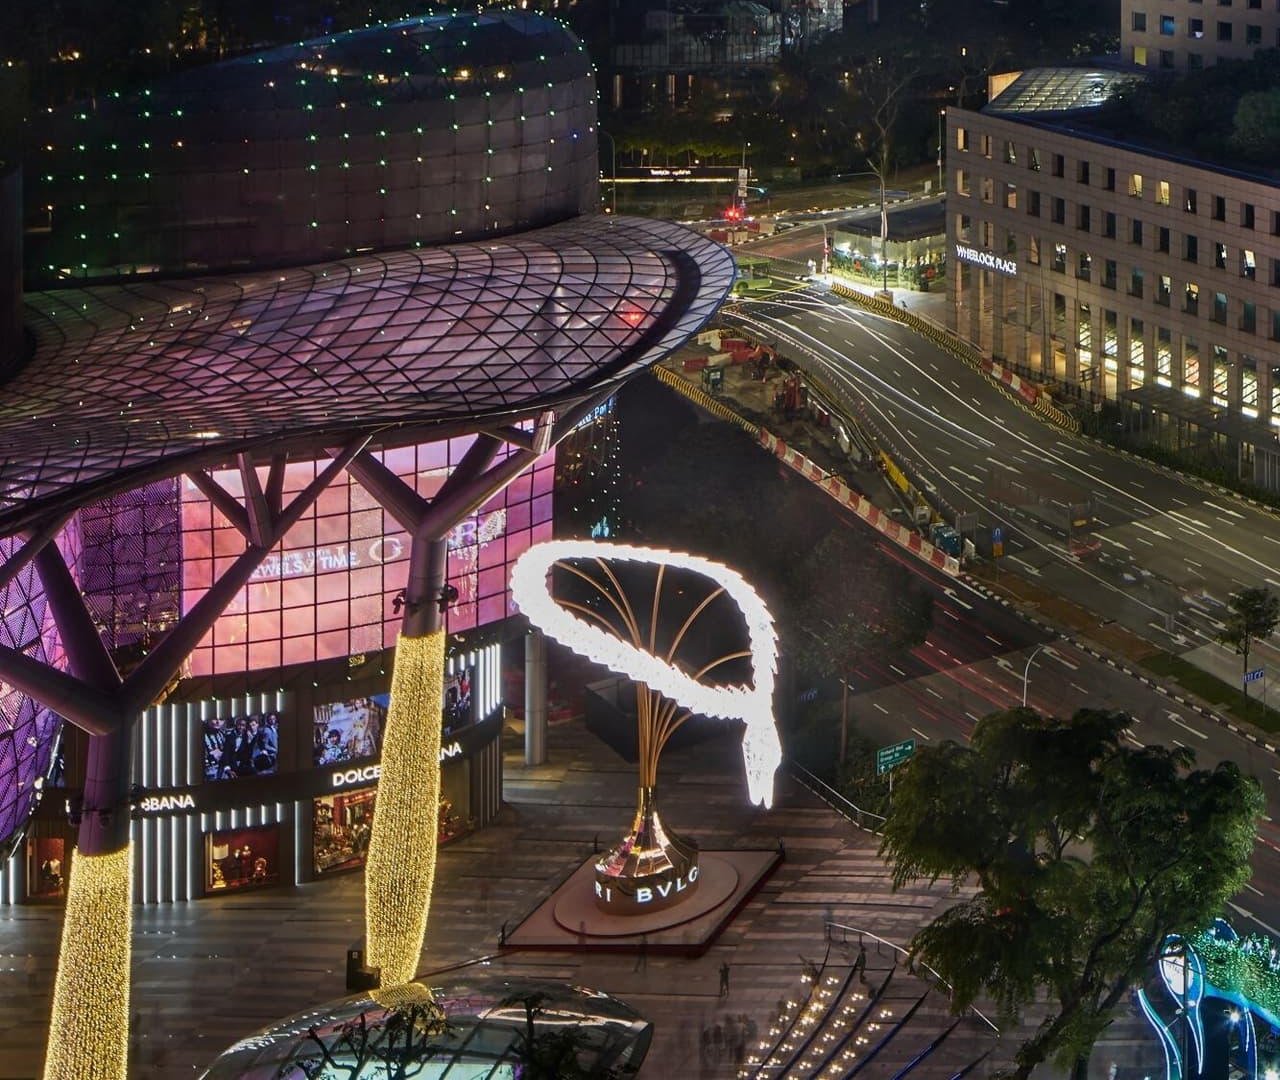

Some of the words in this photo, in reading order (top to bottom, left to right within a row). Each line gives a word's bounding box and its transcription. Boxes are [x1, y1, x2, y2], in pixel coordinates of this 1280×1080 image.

[955, 244, 995, 269] WHEELOCK
[995, 257, 1017, 275] PLACE
[332, 767, 381, 787] DOLCE
